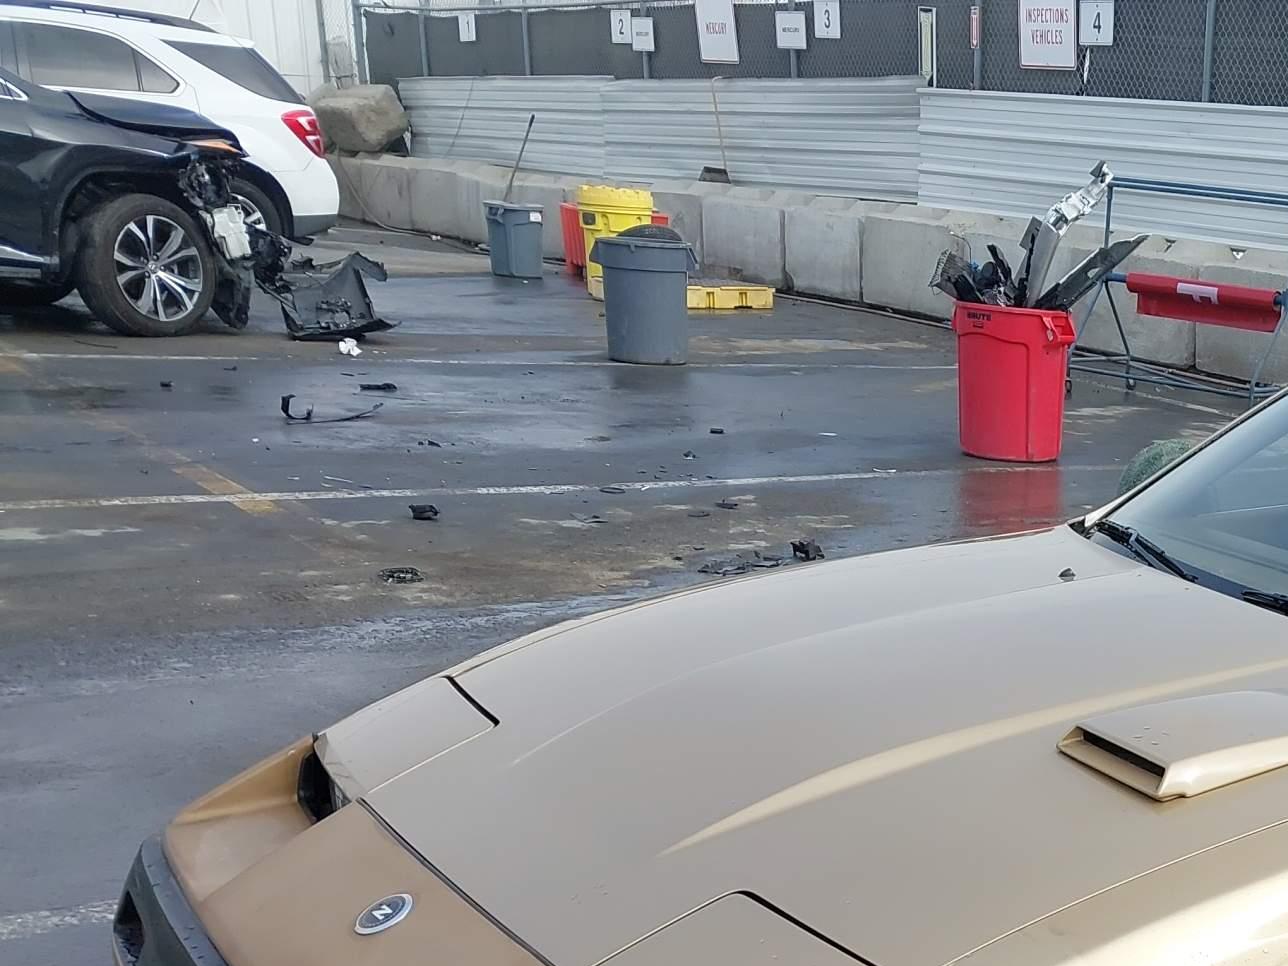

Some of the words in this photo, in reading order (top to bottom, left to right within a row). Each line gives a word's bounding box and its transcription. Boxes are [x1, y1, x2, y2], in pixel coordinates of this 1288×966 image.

[824, 9, 831, 29] 3
[1025, 8, 1069, 24] INSPECTIONS
[1093, 12, 1102, 34] 4
[618, 18, 625, 35] 2
[705, 22, 727, 35] MERCURY
[1031, 29, 1063, 45] VEHICLES
